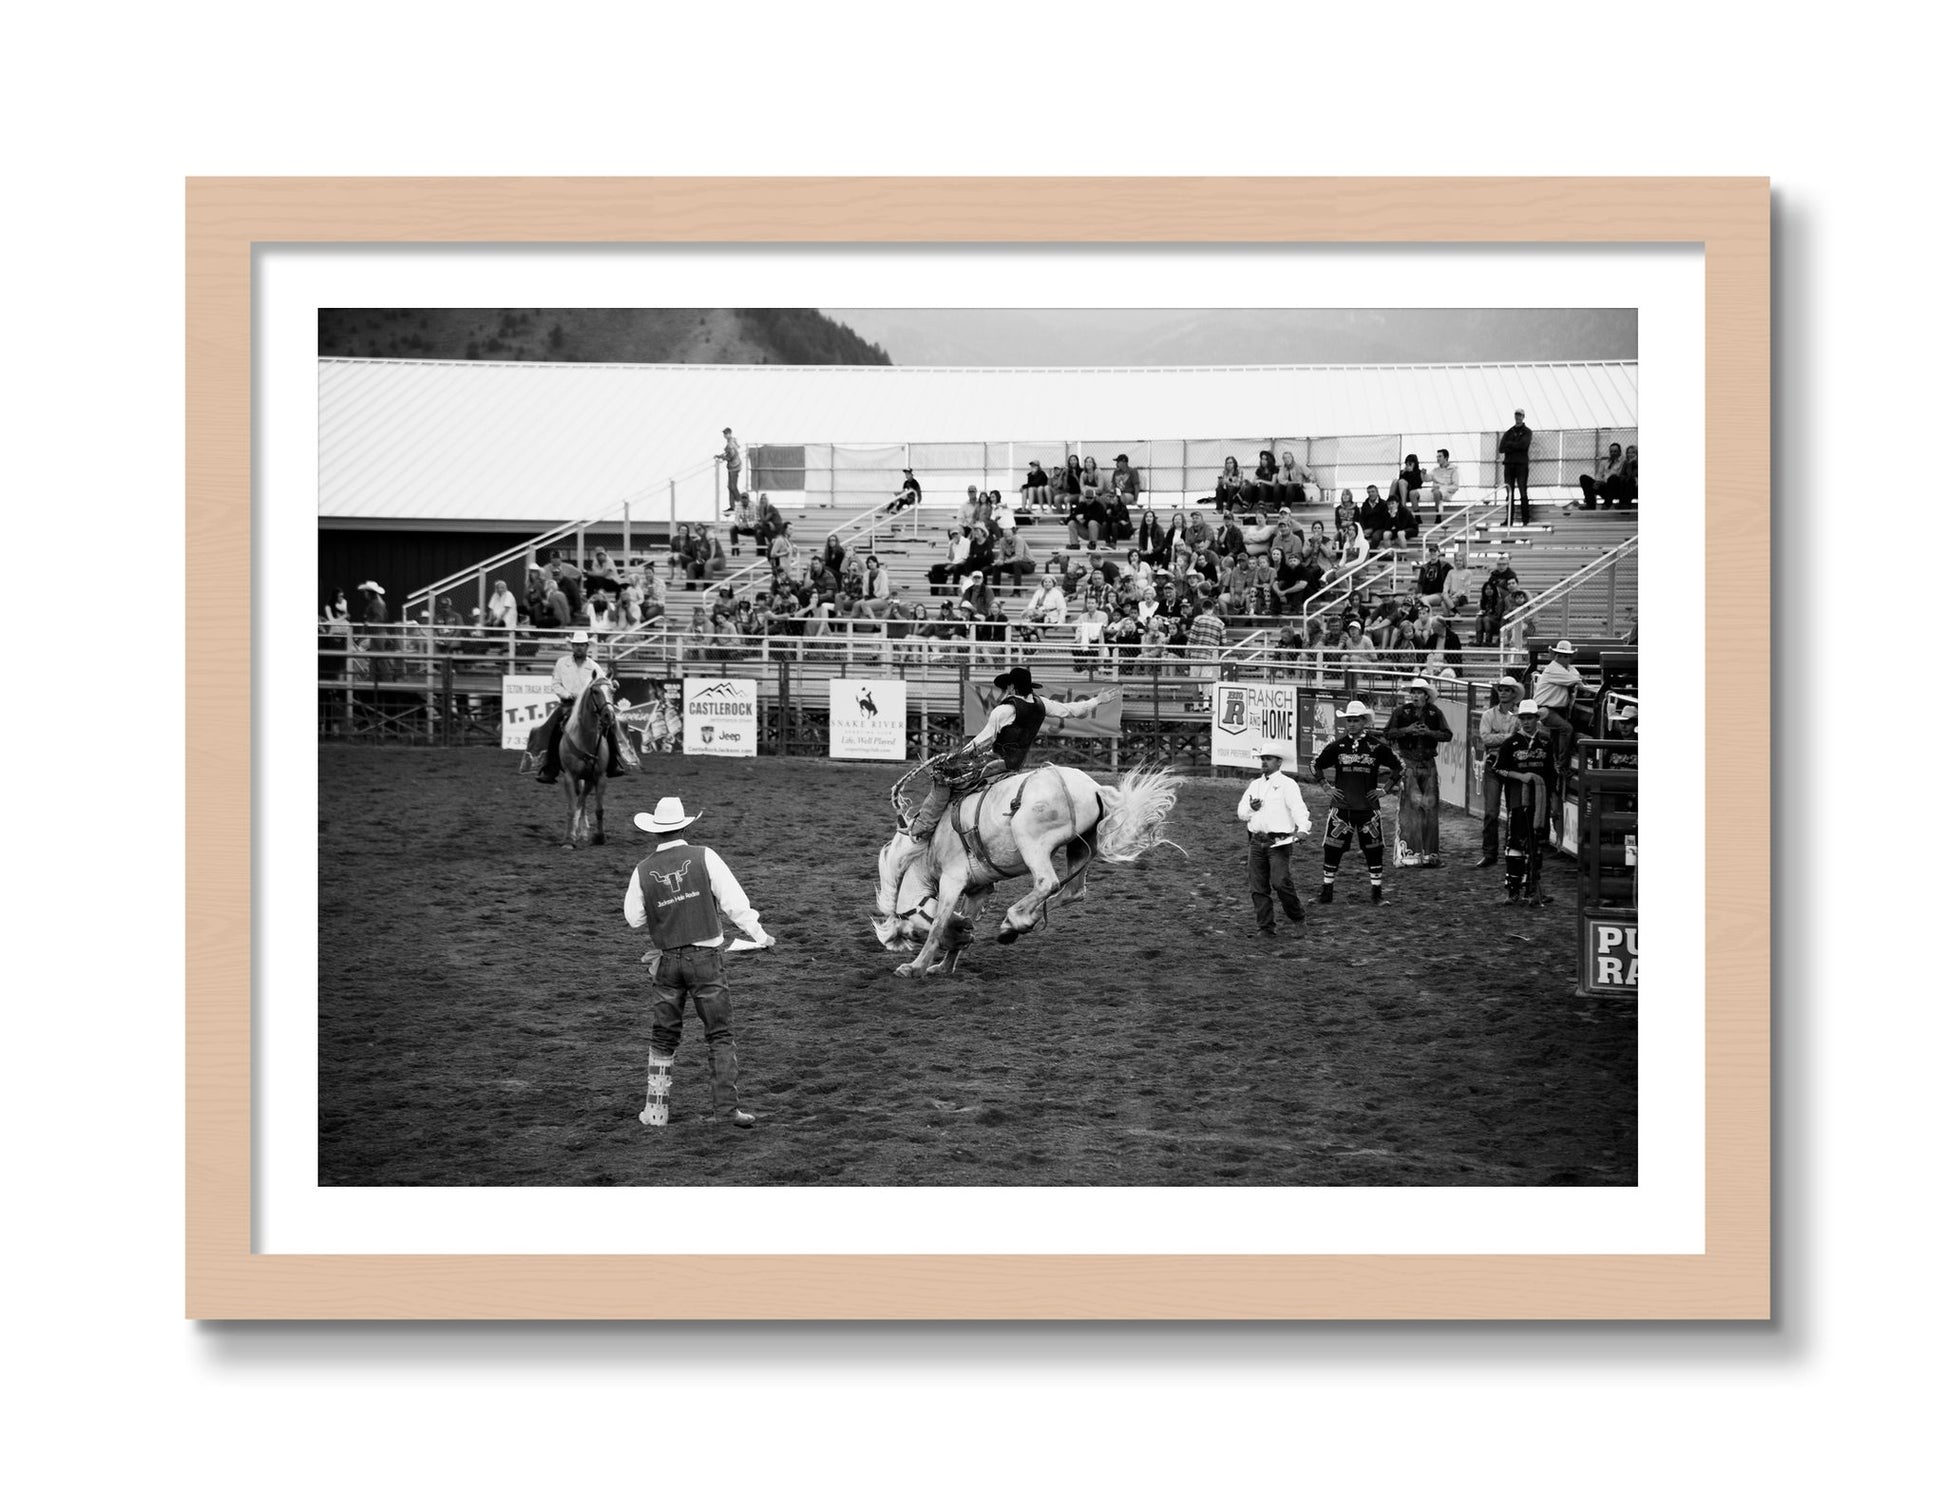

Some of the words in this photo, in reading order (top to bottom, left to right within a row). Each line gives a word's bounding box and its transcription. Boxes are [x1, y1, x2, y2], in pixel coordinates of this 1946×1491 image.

[1248, 688, 1293, 710] RANCH
[689, 702, 753, 716] CASTLEROCK
[1222, 700, 1245, 726] R
[831, 720, 865, 728] SNAKE
[872, 720, 905, 728] RIVER
[1262, 709, 1293, 741] HOME
[719, 731, 742, 742] Jeep
[657, 898, 674, 907] Jackson
